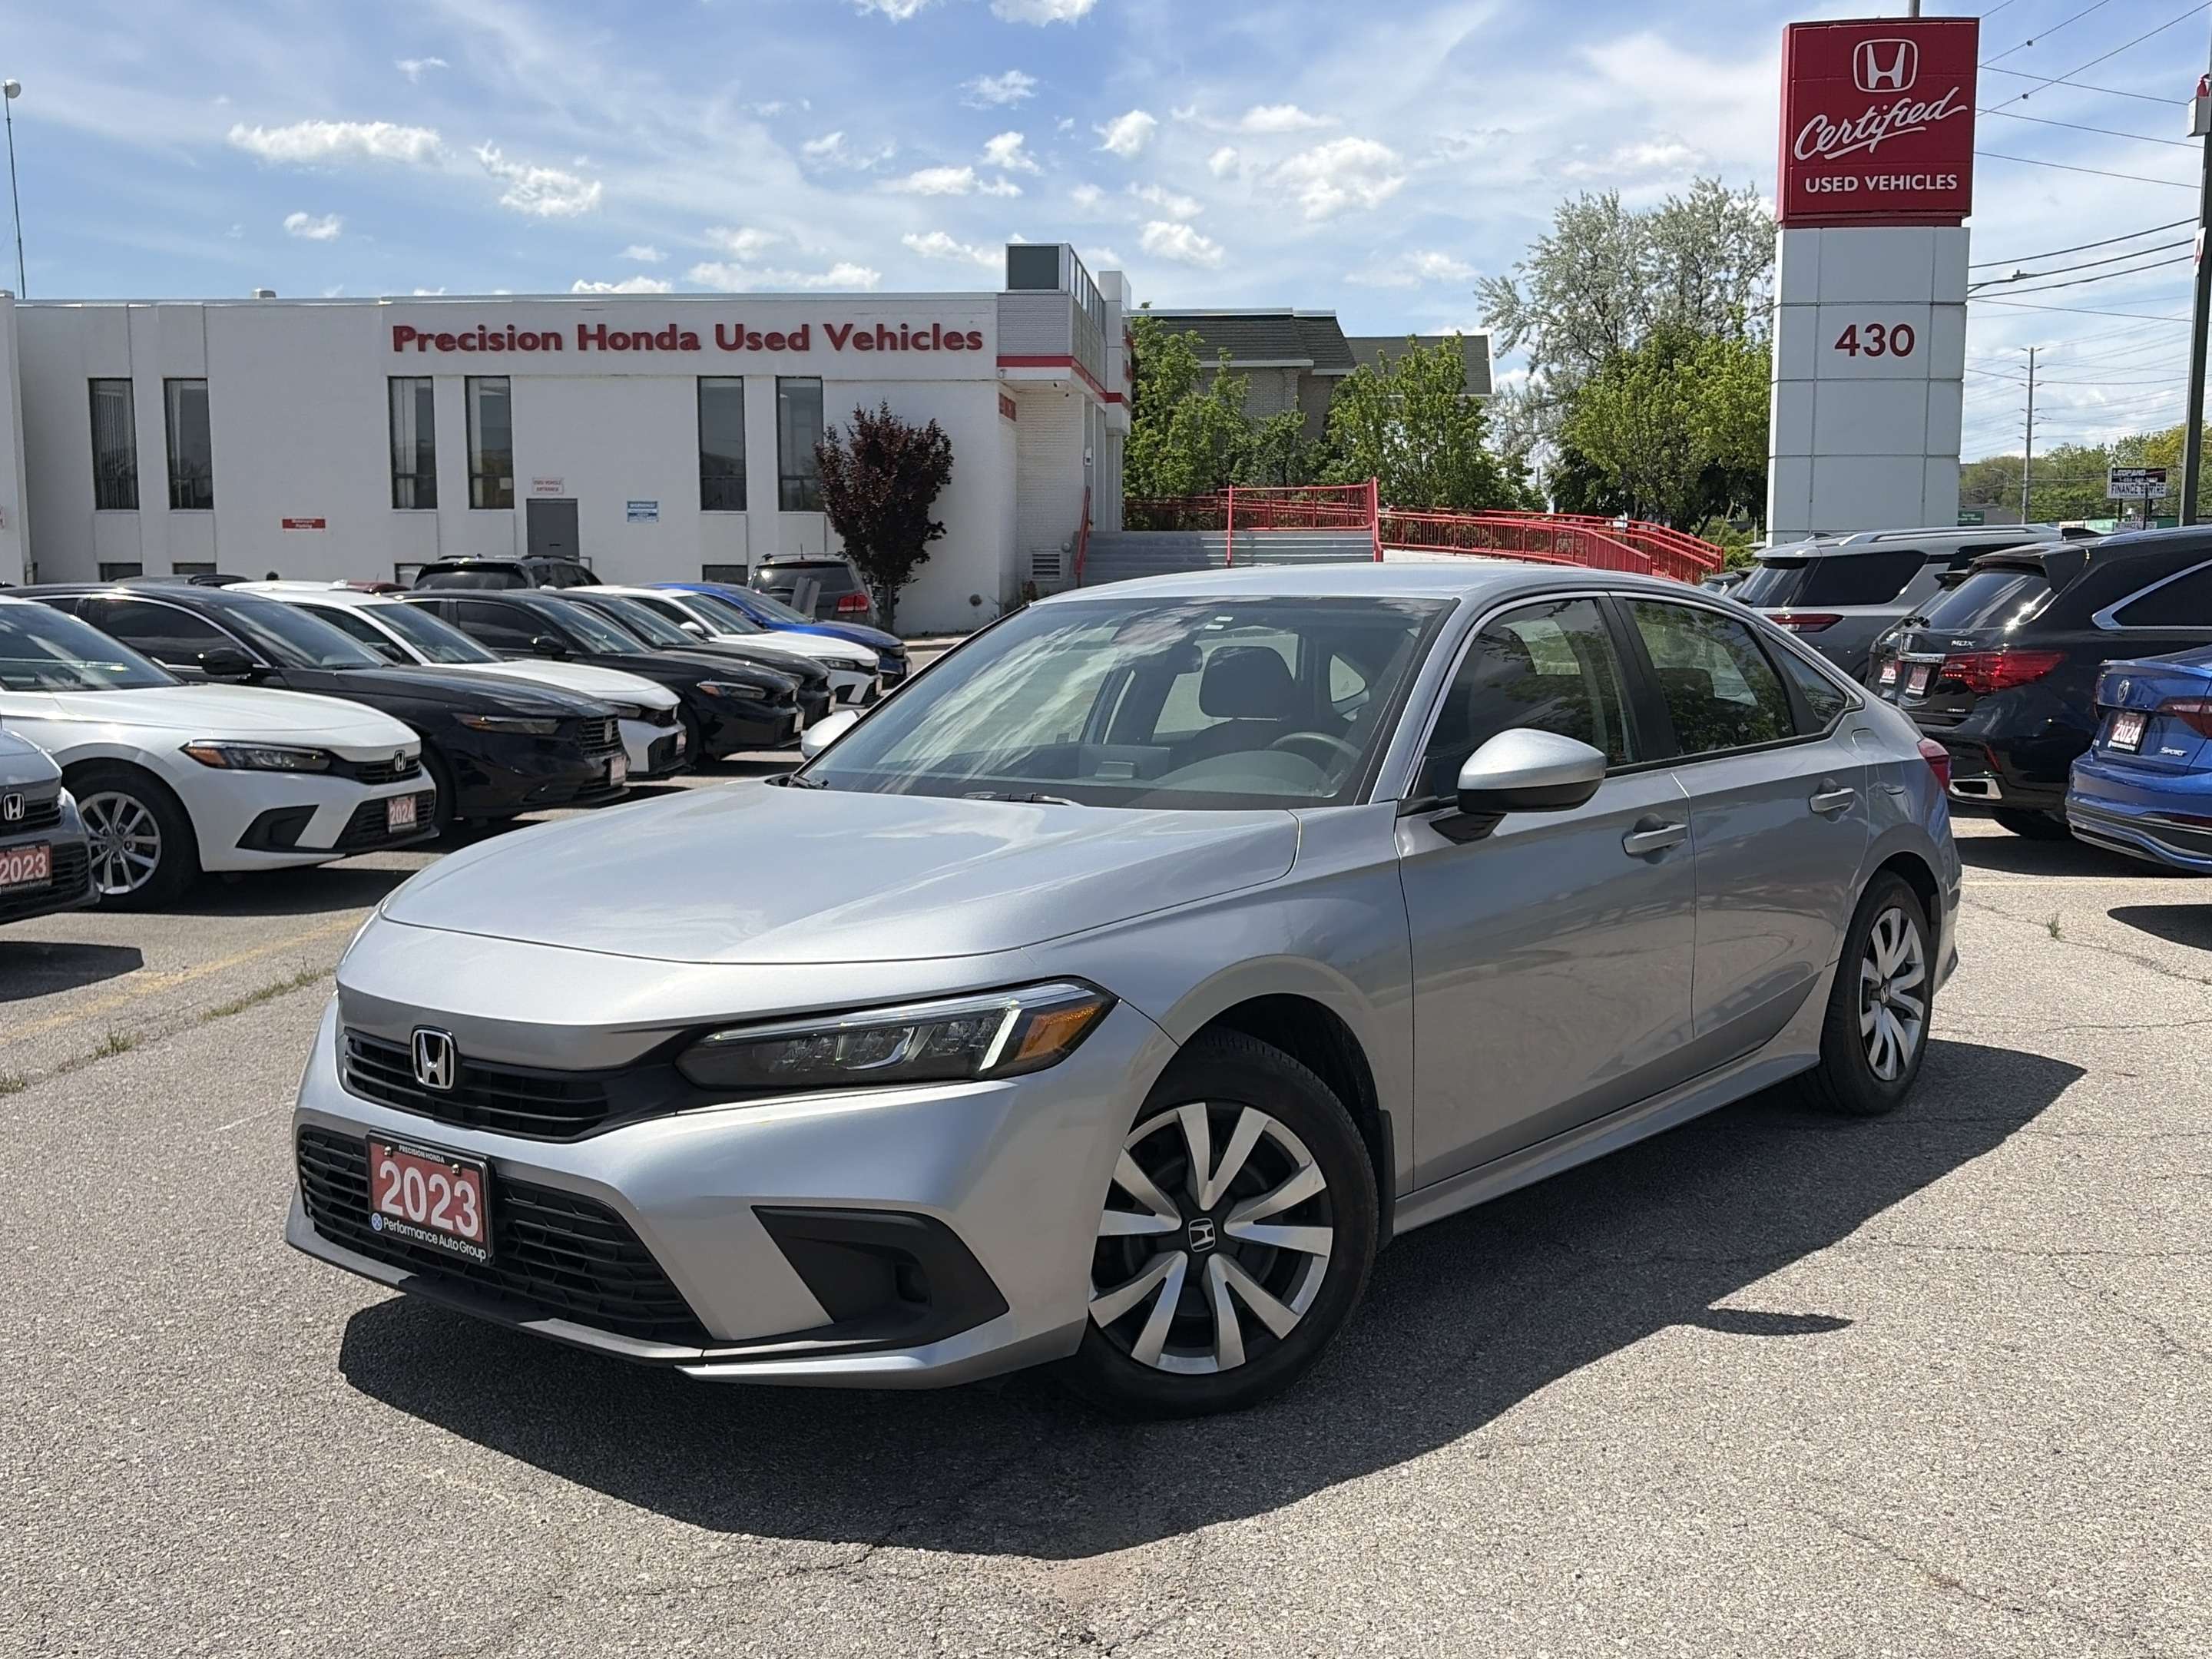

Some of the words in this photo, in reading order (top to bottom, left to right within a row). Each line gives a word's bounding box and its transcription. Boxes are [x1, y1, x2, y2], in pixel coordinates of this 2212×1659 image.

[1794, 86, 1968, 161] Certified
[1805, 176, 1859, 193] USED
[1864, 174, 1958, 190] VEHICLES
[392, 323, 563, 352] Precision
[578, 323, 701, 352] Honda
[714, 323, 810, 352] Used
[823, 322, 983, 352] Vehicles
[1834, 323, 1915, 357] 430
[2111, 483, 2138, 495] FINANCE
[2111, 720, 2143, 744] 2024
[389, 803, 415, 825] 2024
[0, 852, 47, 885] 2023
[399, 1144, 426, 1158] PRECISION
[425, 1151, 445, 1164] HONDA
[379, 1160, 479, 1237] 2023
[383, 1217, 439, 1245] Performance
[439, 1235, 459, 1251] Auto
[459, 1240, 487, 1263] Group
